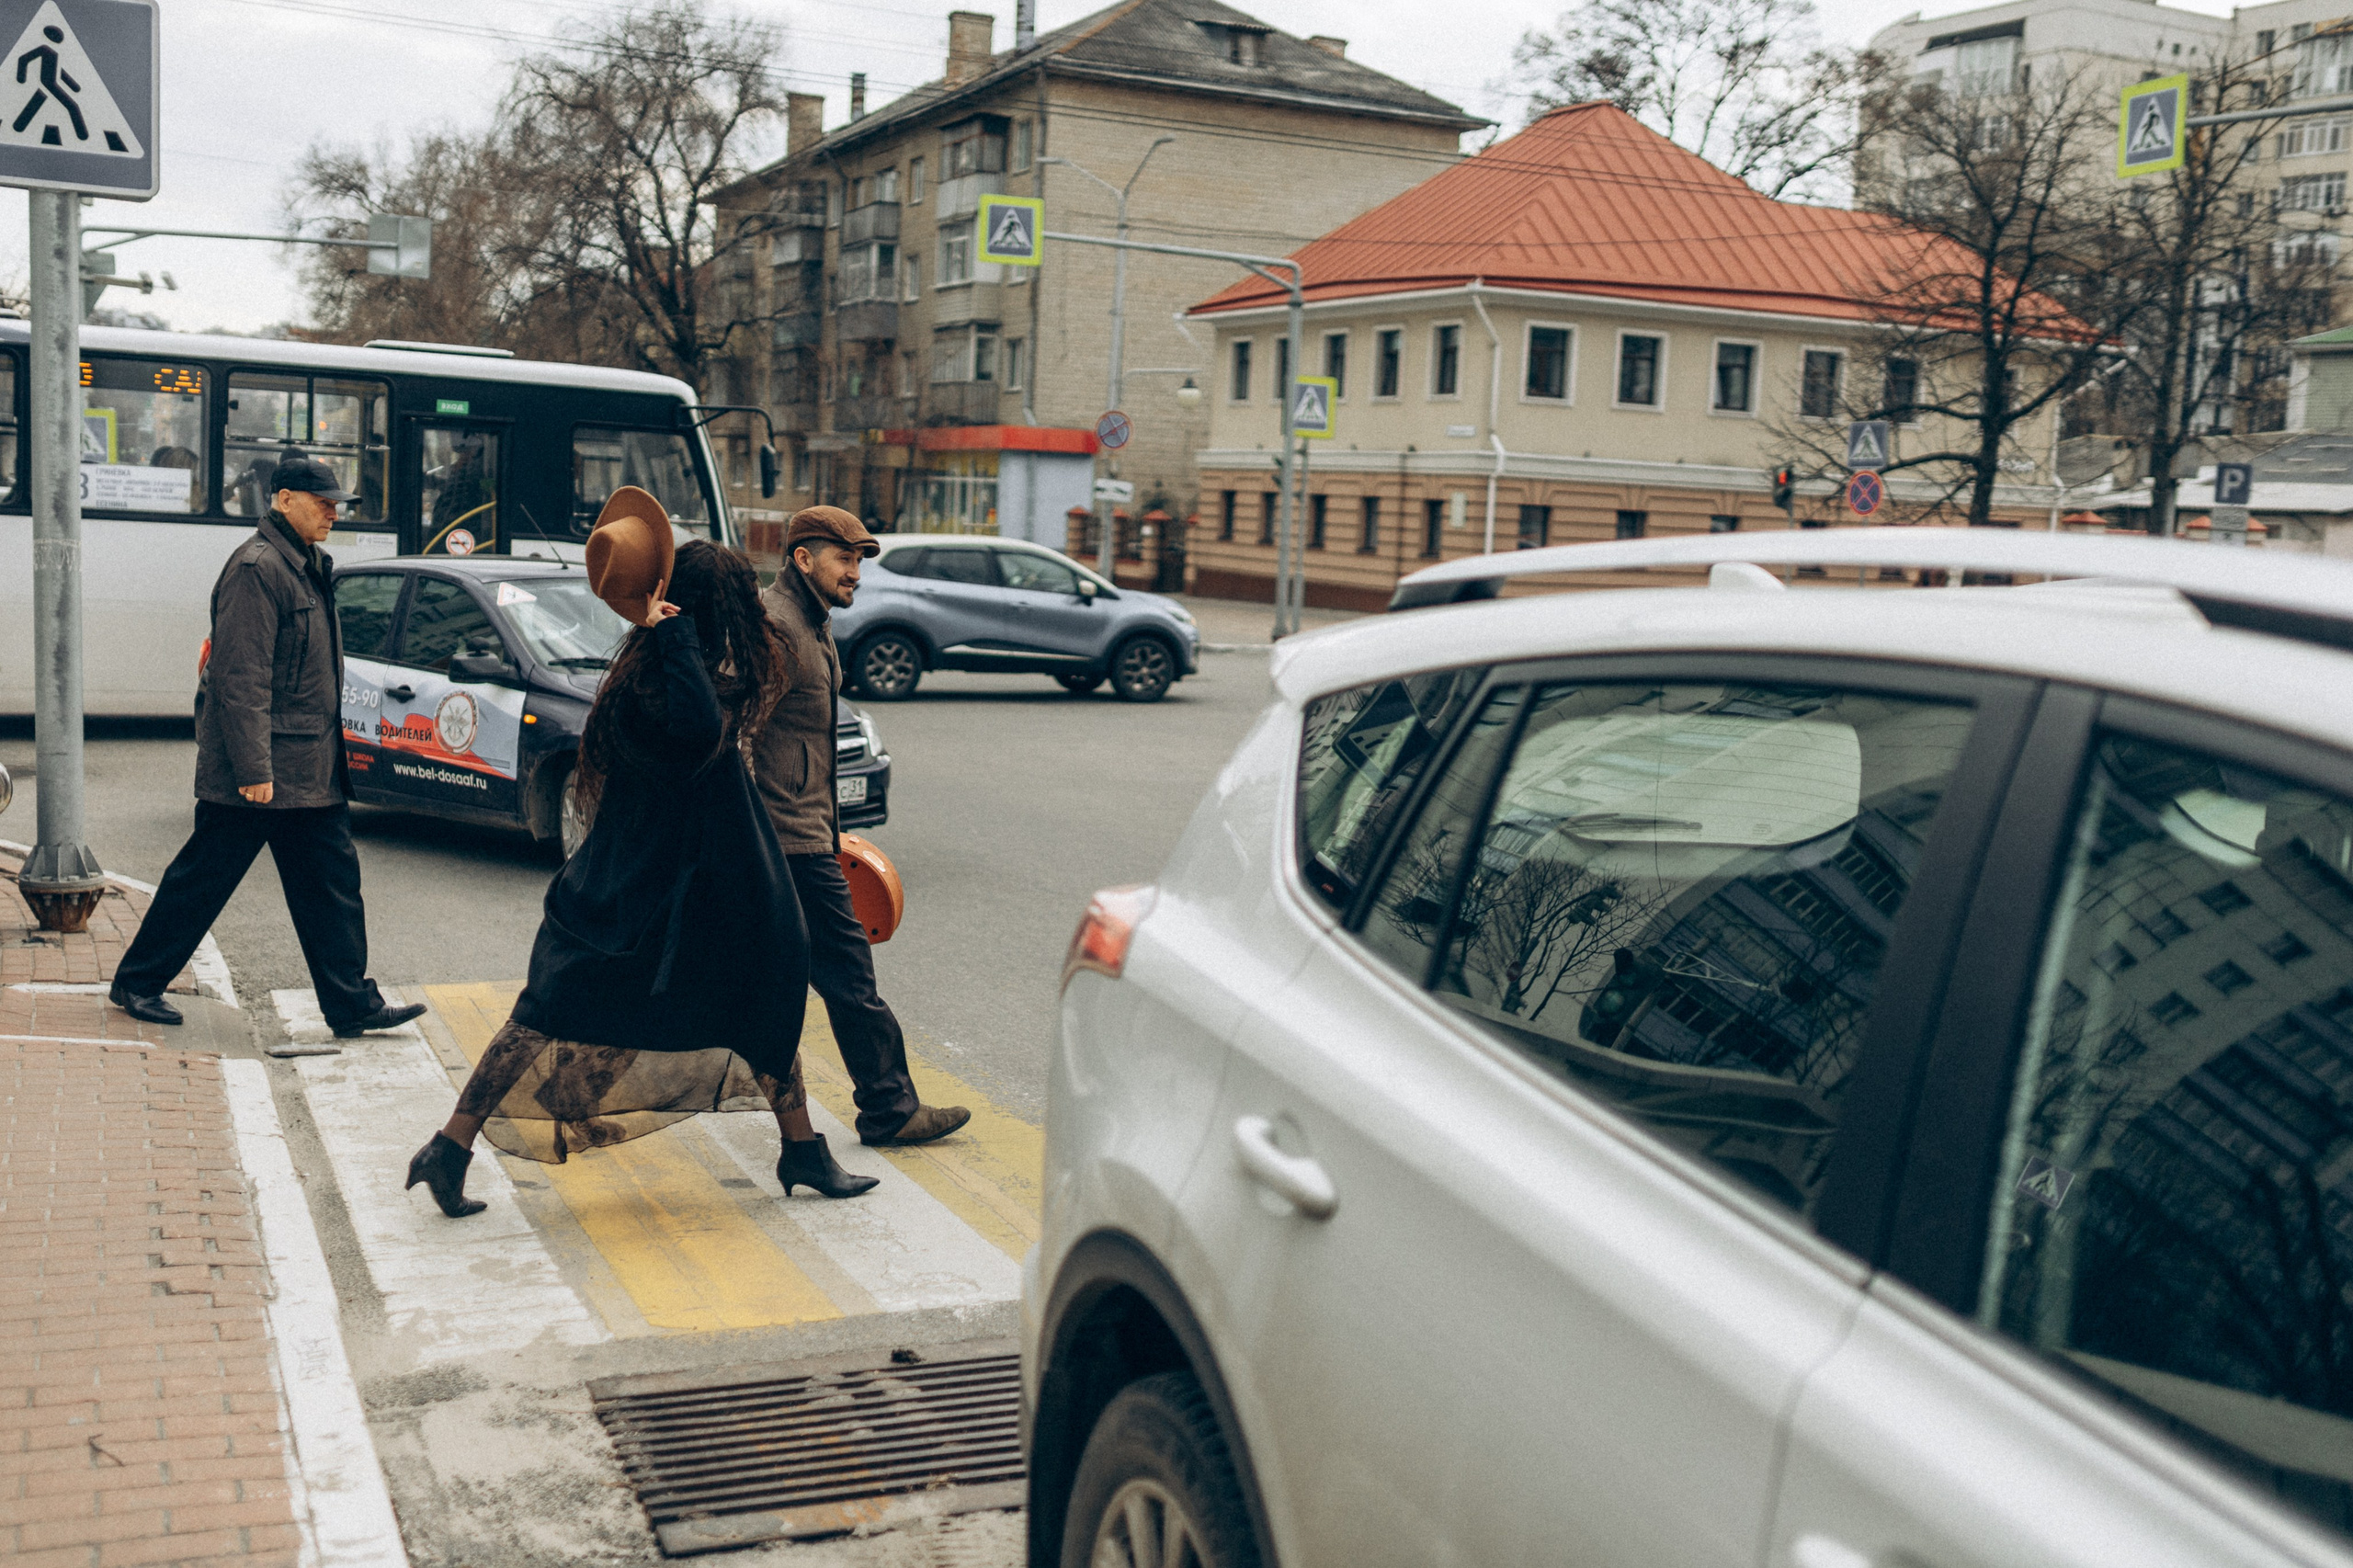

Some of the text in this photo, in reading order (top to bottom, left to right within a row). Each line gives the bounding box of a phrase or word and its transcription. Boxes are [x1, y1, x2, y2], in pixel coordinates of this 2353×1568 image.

[441, 403, 464, 412] ВХОД
[2222, 468, 2245, 498] P
[376, 725, 432, 742] ВОДИТЕЛЕЙ
[393, 764, 487, 789] www.bel-dosaaf.ru
[851, 780, 862, 792] 31
